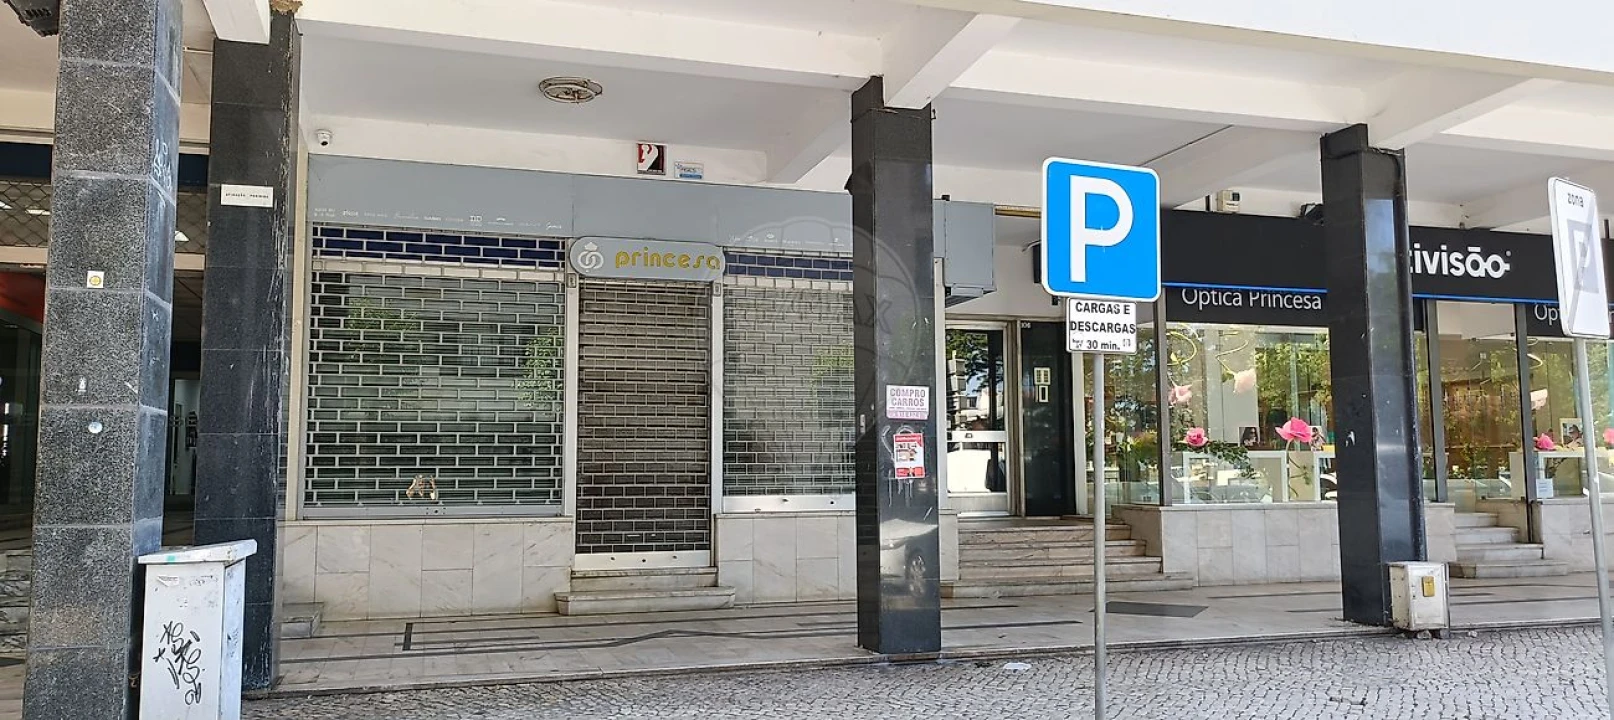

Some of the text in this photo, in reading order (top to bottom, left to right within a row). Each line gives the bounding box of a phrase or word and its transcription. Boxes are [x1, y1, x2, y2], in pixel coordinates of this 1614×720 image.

[1567, 192, 1584, 208] zona
[1069, 174, 1133, 282] P
[615, 246, 720, 270] princesa
[1249, 290, 1322, 310] Princesa
[1075, 301, 1131, 315] CARGAS E
[1070, 320, 1136, 334] DESCARGAS
[1086, 339, 1099, 350] 30
[889, 388, 926, 398] COMPRO
[890, 397, 925, 407] CARROS
